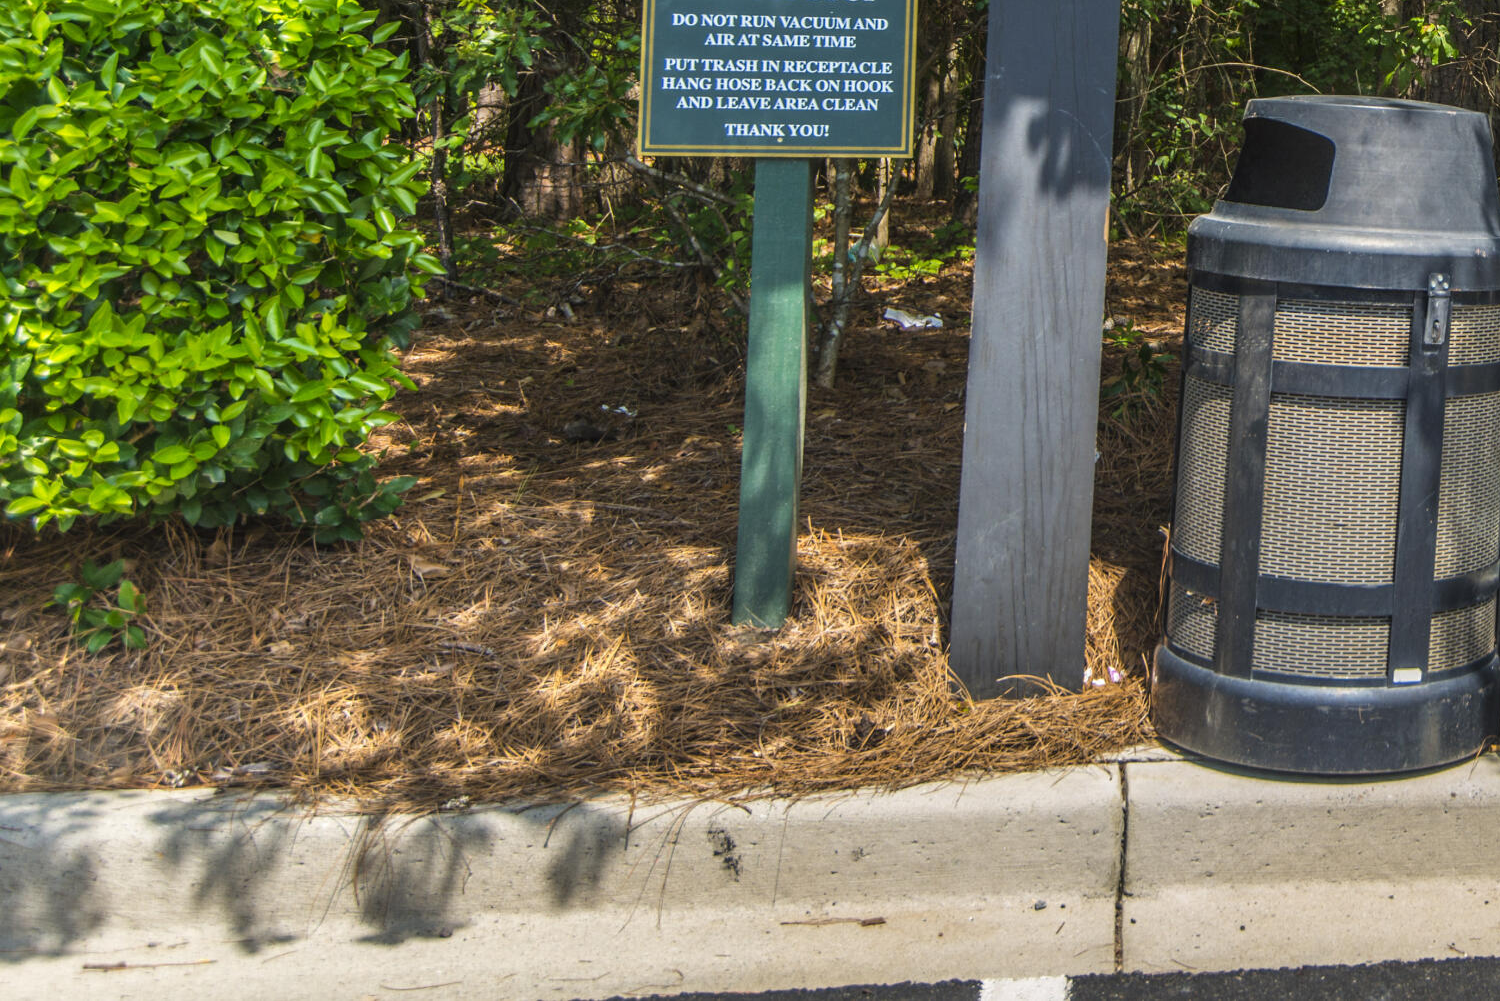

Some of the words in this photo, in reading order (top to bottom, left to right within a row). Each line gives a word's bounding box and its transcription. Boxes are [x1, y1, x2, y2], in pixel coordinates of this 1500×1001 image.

[672, 13, 699, 26] DO
[701, 13, 738, 27] NOT
[741, 14, 777, 28] RUN
[779, 15, 851, 30] VACUUM
[853, 17, 889, 31] AND
[704, 33, 735, 46] AIR
[737, 33, 760, 46] AT
[762, 34, 811, 48] SAME
[812, 35, 857, 48] TIME
[665, 57, 699, 71] PUT
[701, 58, 759, 72] TRASH
[762, 59, 780, 73] IN
[783, 60, 893, 75] RECEPTACLE
[662, 76, 712, 90] HANG
[716, 77, 762, 91] HOSE
[765, 78, 812, 92] BACK
[815, 79, 841, 92] ON
[844, 79, 894, 93] HOOK
[676, 96, 713, 109] AND
[716, 96, 771, 110] LEAVE
[773, 97, 819, 111] AREA
[822, 98, 879, 111] CLEAN
[724, 123, 785, 137] THANK
[788, 124, 830, 137] YOU!
